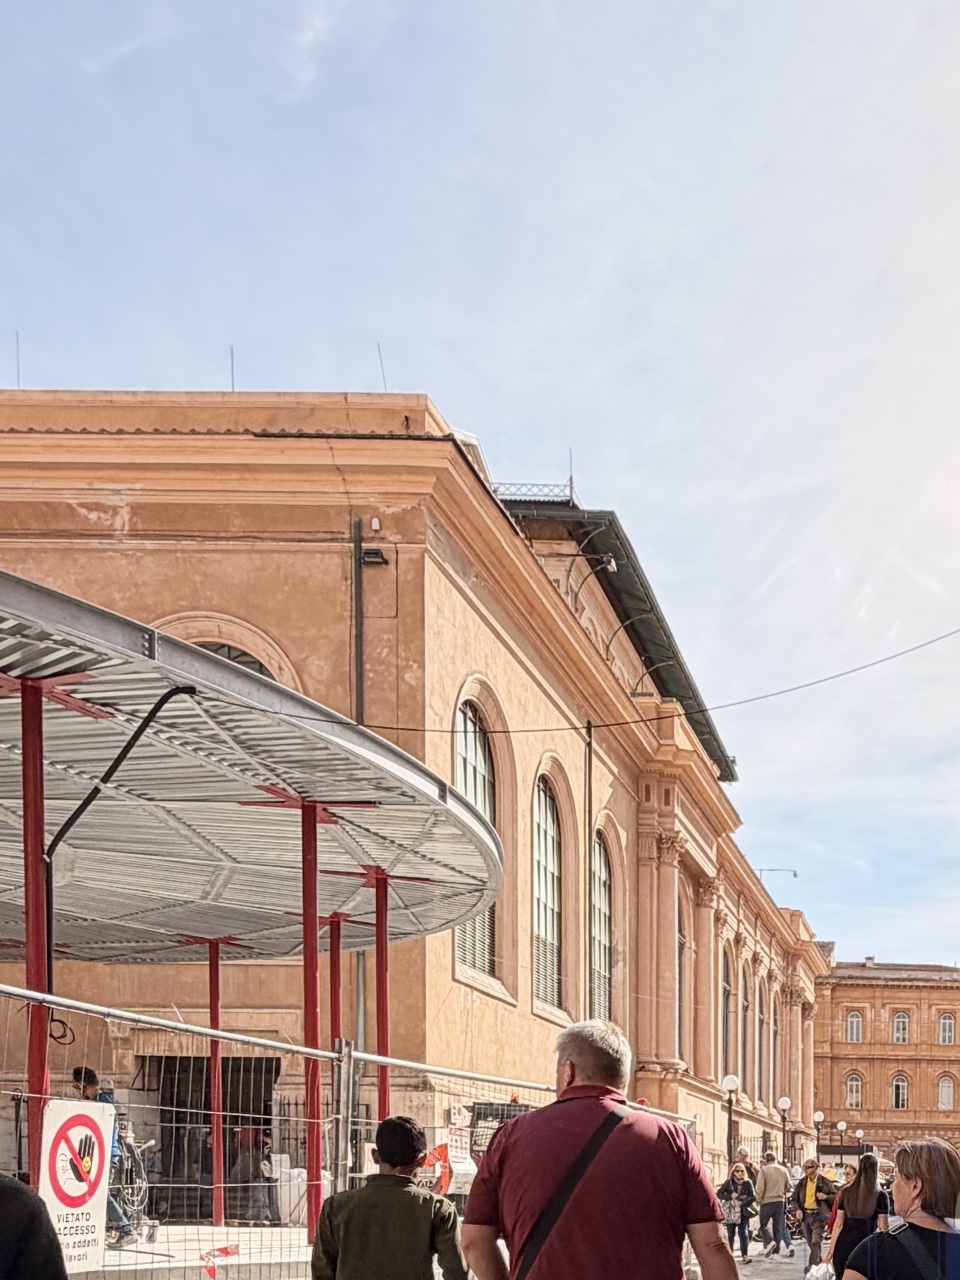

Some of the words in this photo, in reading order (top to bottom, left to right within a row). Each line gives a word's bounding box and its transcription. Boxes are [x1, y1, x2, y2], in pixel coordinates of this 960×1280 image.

[57, 1212, 91, 1223] VIETATO
[57, 1224, 96, 1236] ACCESSO
[72, 1238, 99, 1249] addetti
[66, 1251, 88, 1262] lavori
